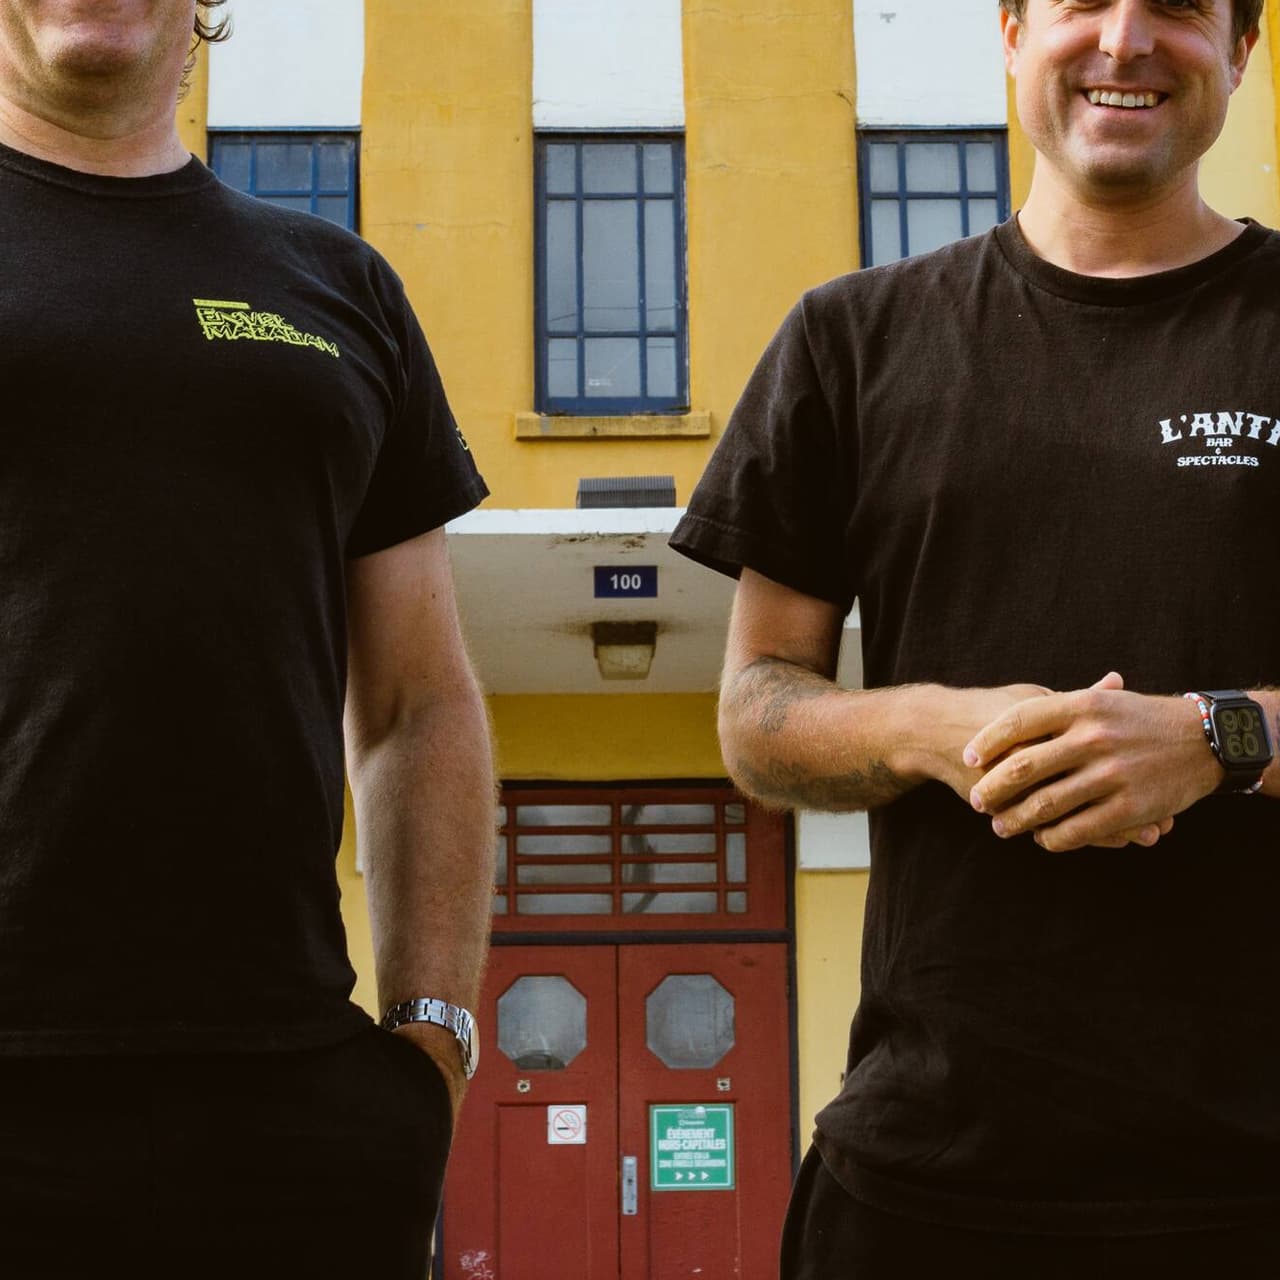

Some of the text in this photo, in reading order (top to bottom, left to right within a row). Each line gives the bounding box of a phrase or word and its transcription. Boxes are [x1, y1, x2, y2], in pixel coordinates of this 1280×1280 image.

[1206, 438, 1233, 447] BAR
[1177, 456, 1259, 467] SPECTACLES
[610, 574, 641, 589] 100
